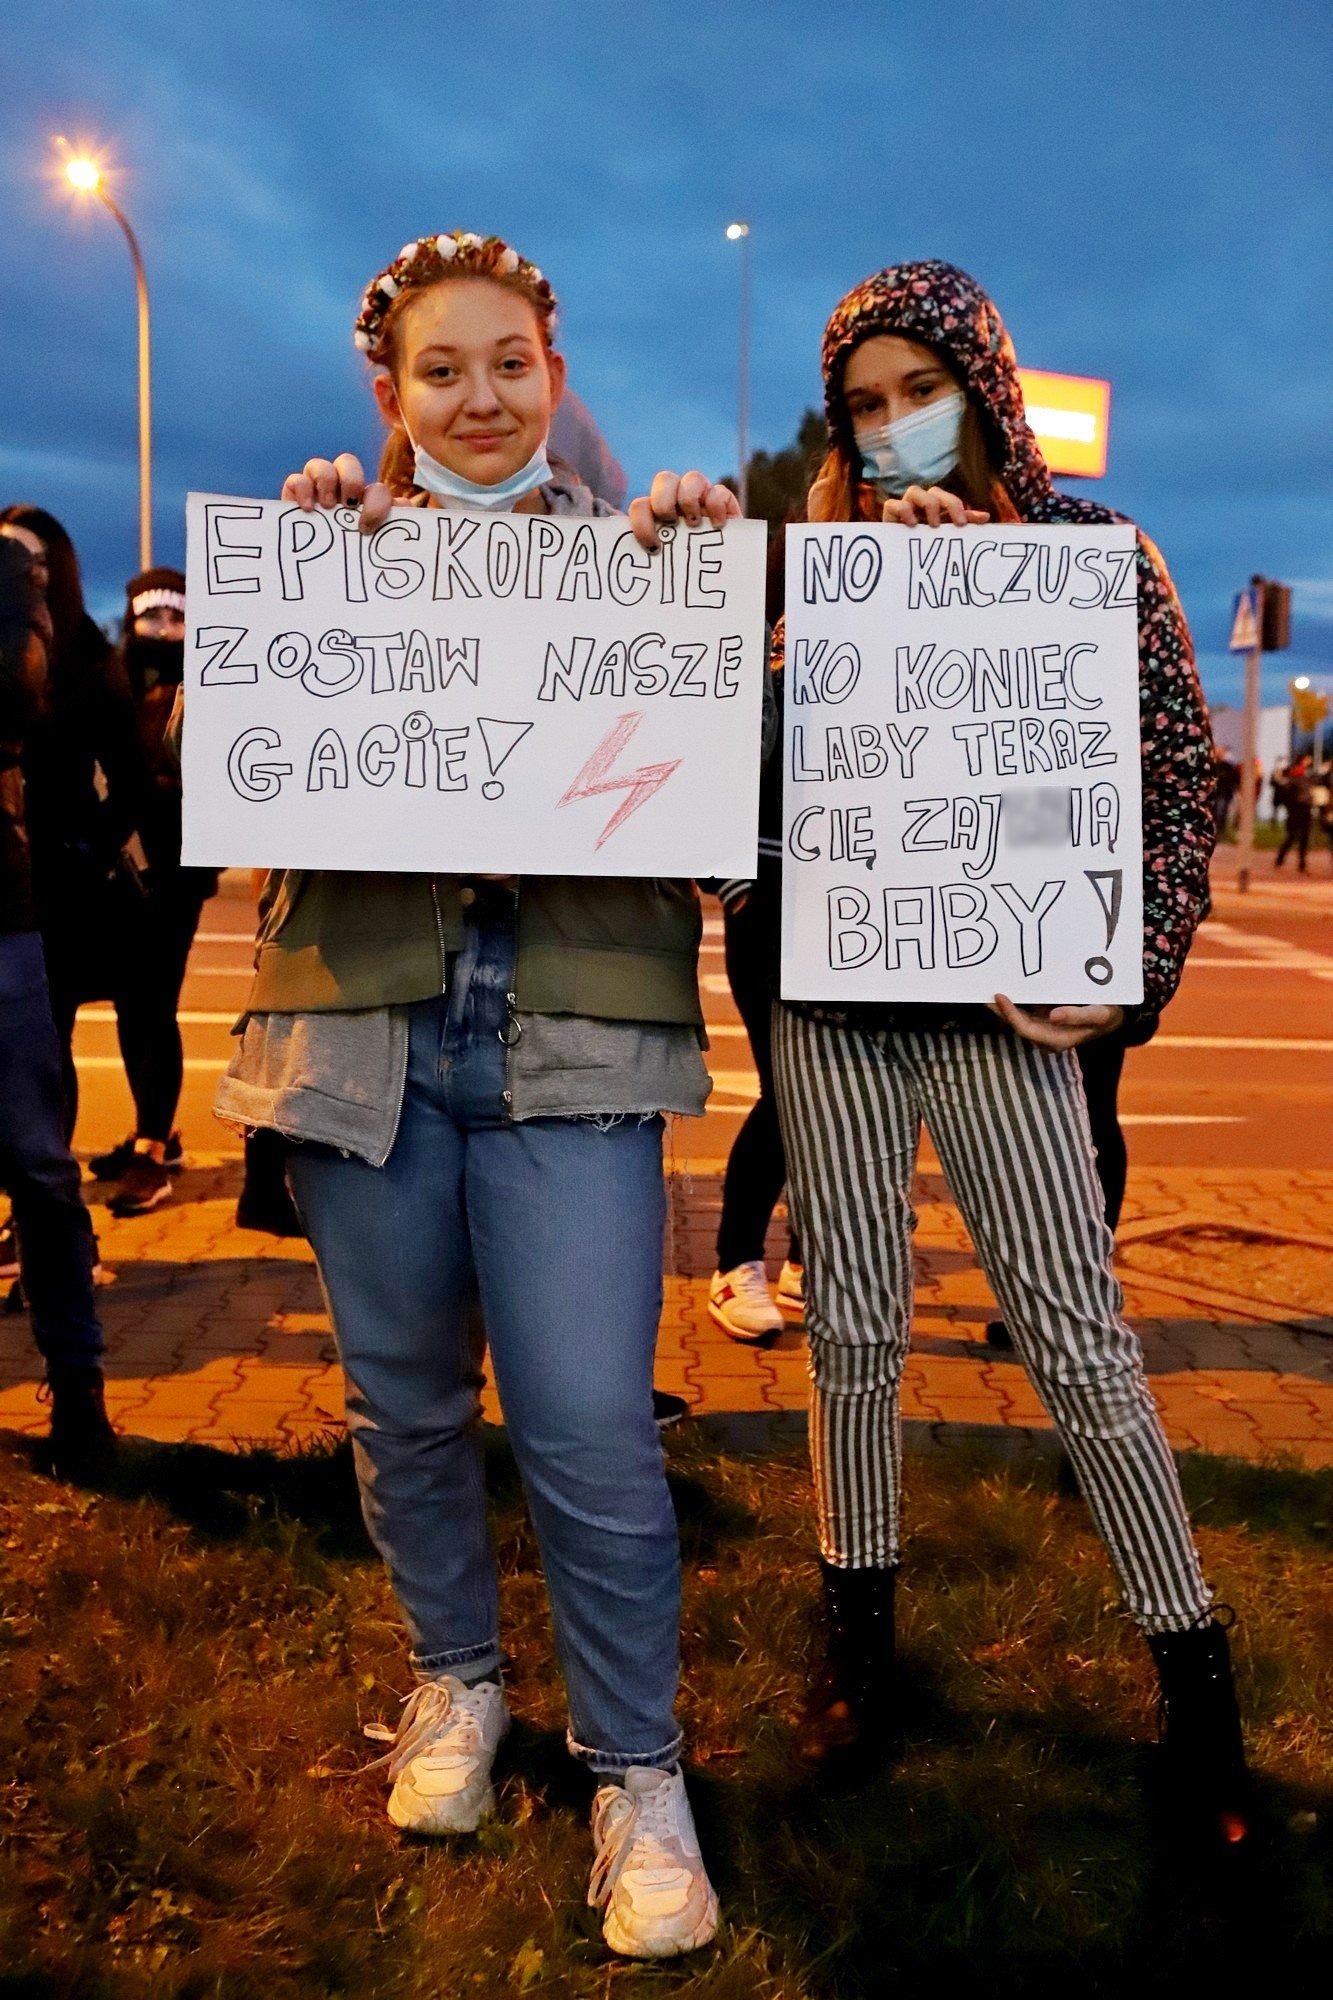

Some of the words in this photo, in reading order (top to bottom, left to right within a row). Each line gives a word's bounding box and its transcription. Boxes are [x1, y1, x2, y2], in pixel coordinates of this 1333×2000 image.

[803, 536, 882, 605] NO
[908, 537, 1138, 611] KACZUSZ
[195, 626, 480, 698] ZOSTAW
[537, 632, 743, 702] NASZE
[793, 638, 861, 705] KO
[896, 643, 1103, 713] KONIEC
[792, 723, 929, 782] LABY
[953, 717, 1119, 777] TERAZ
[789, 805, 877, 871] CIĘ
[901, 782, 1120, 881] ZAJIĄ
